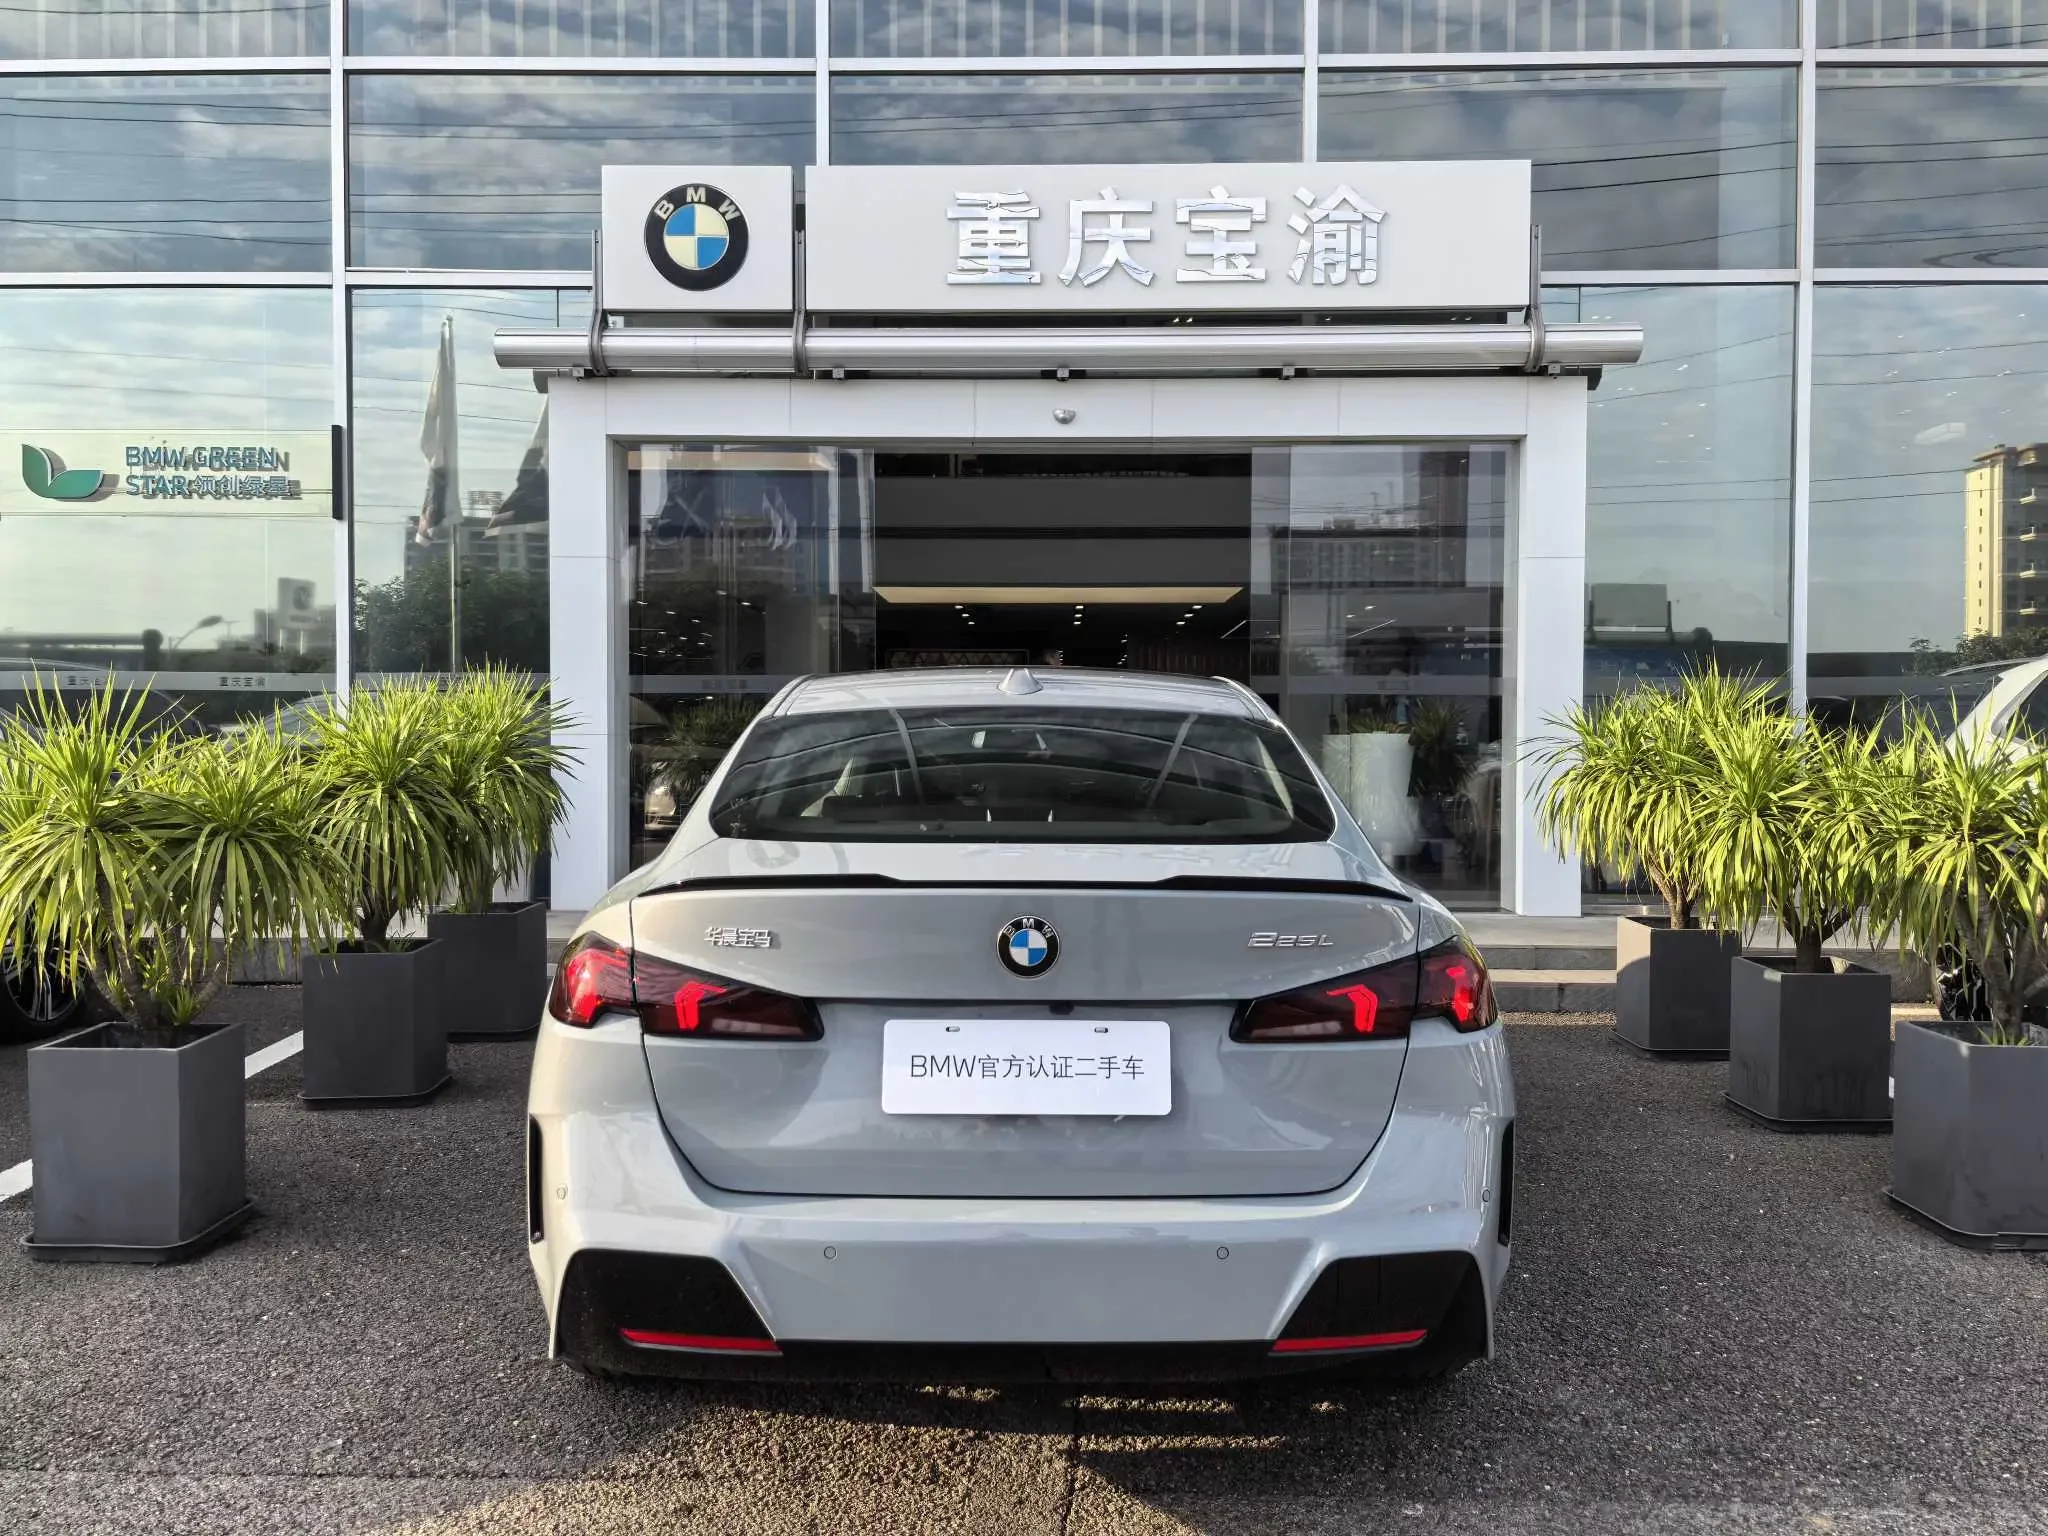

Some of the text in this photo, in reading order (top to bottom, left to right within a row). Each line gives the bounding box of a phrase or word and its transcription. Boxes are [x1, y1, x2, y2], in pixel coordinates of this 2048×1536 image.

[654, 187, 740, 220] BMW
[945, 184, 1388, 287] 重庆宝渝
[125, 446, 277, 467] BMW GREEN
[126, 474, 189, 496] STAR
[703, 927, 771, 947] 华晨宝马
[1003, 918, 1054, 939] BMW
[910, 1053, 1145, 1080] BMW官方认证二手车
